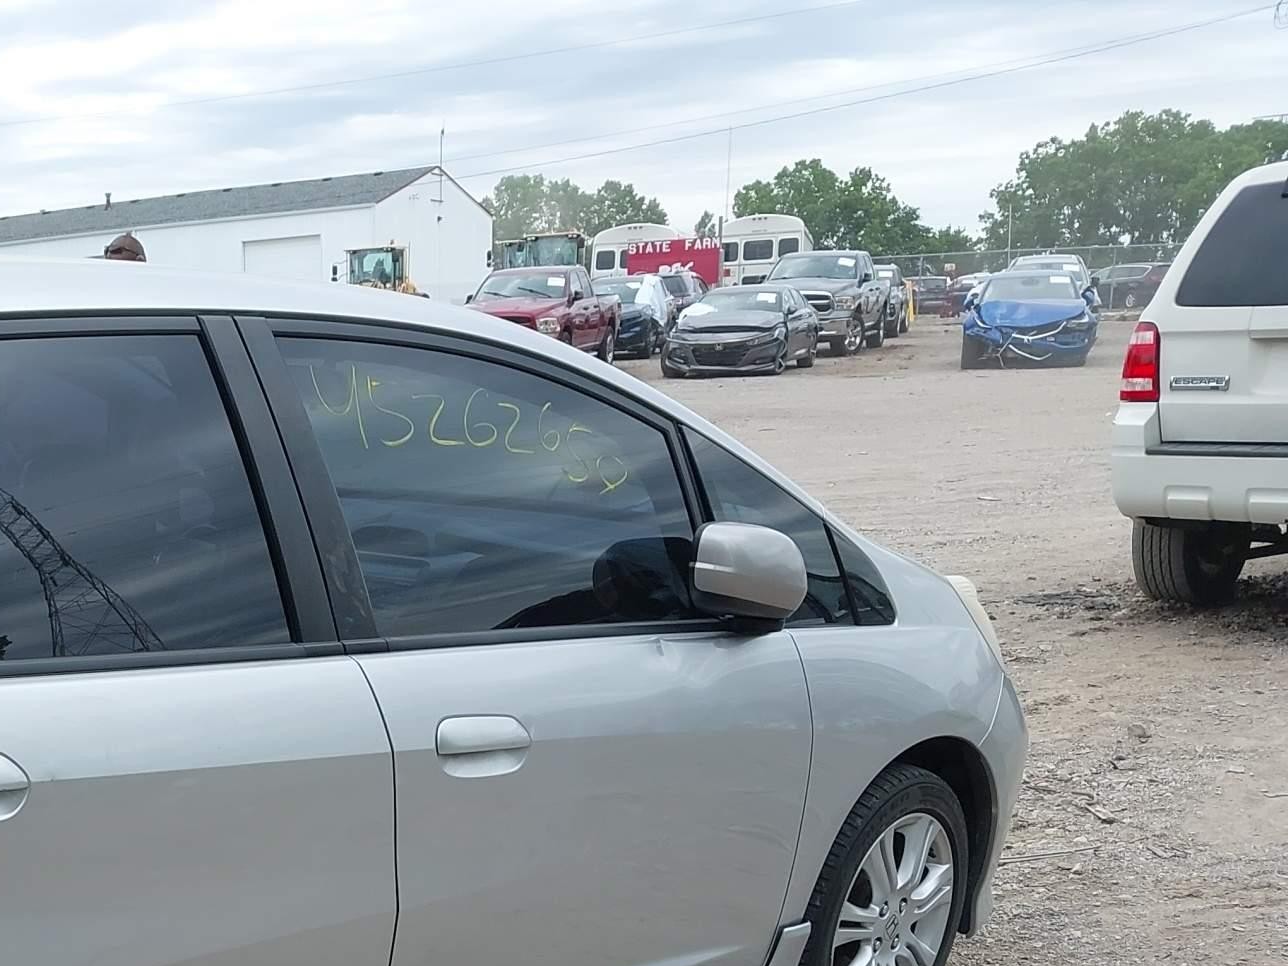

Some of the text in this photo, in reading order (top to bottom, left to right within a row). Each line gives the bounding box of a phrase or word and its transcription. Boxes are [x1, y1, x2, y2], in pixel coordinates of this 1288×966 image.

[627, 236, 721, 255] STATE FARM
[1173, 376, 1226, 386] ESCAPE
